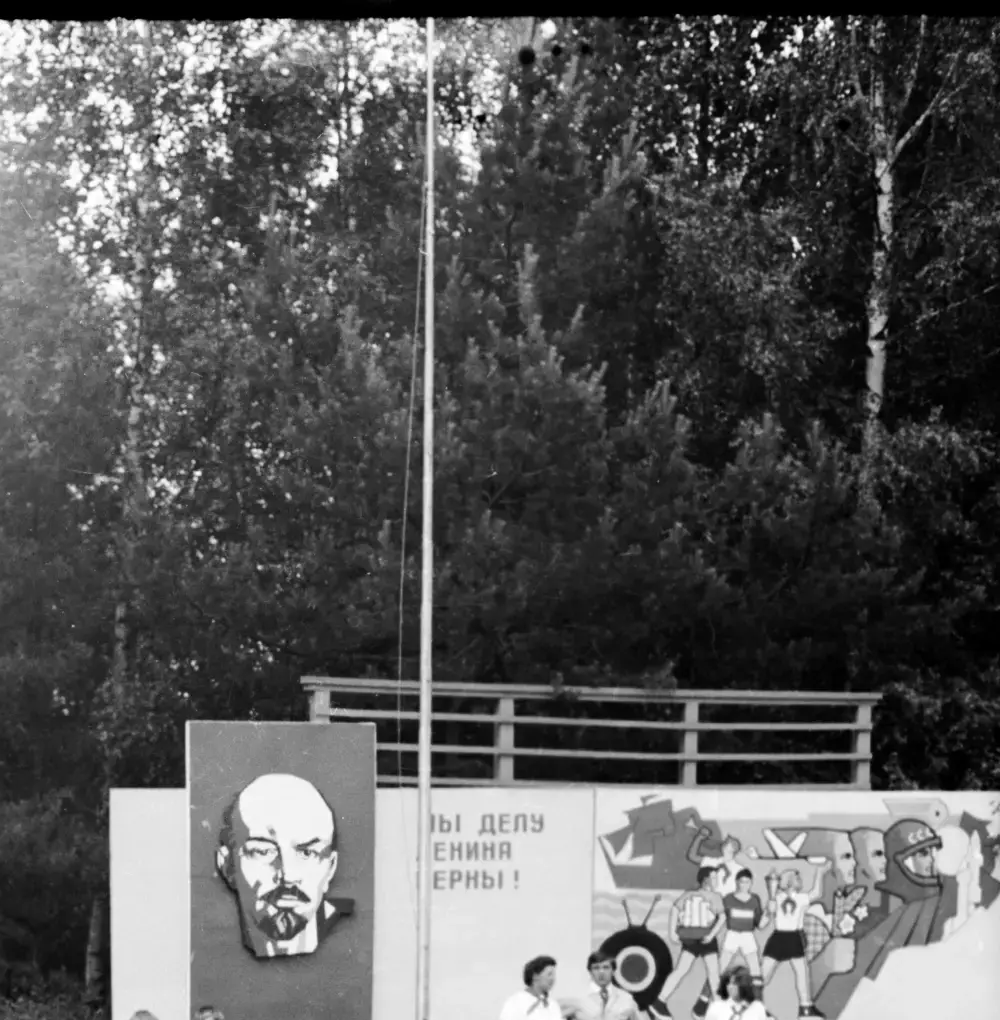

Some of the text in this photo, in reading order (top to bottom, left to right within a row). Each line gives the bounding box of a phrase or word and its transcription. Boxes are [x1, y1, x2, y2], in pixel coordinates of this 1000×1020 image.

[478, 812, 545, 836] ДЕЛУ
[432, 841, 512, 862] ЕНИНА
[432, 869, 519, 890] ЕРНЫ!
